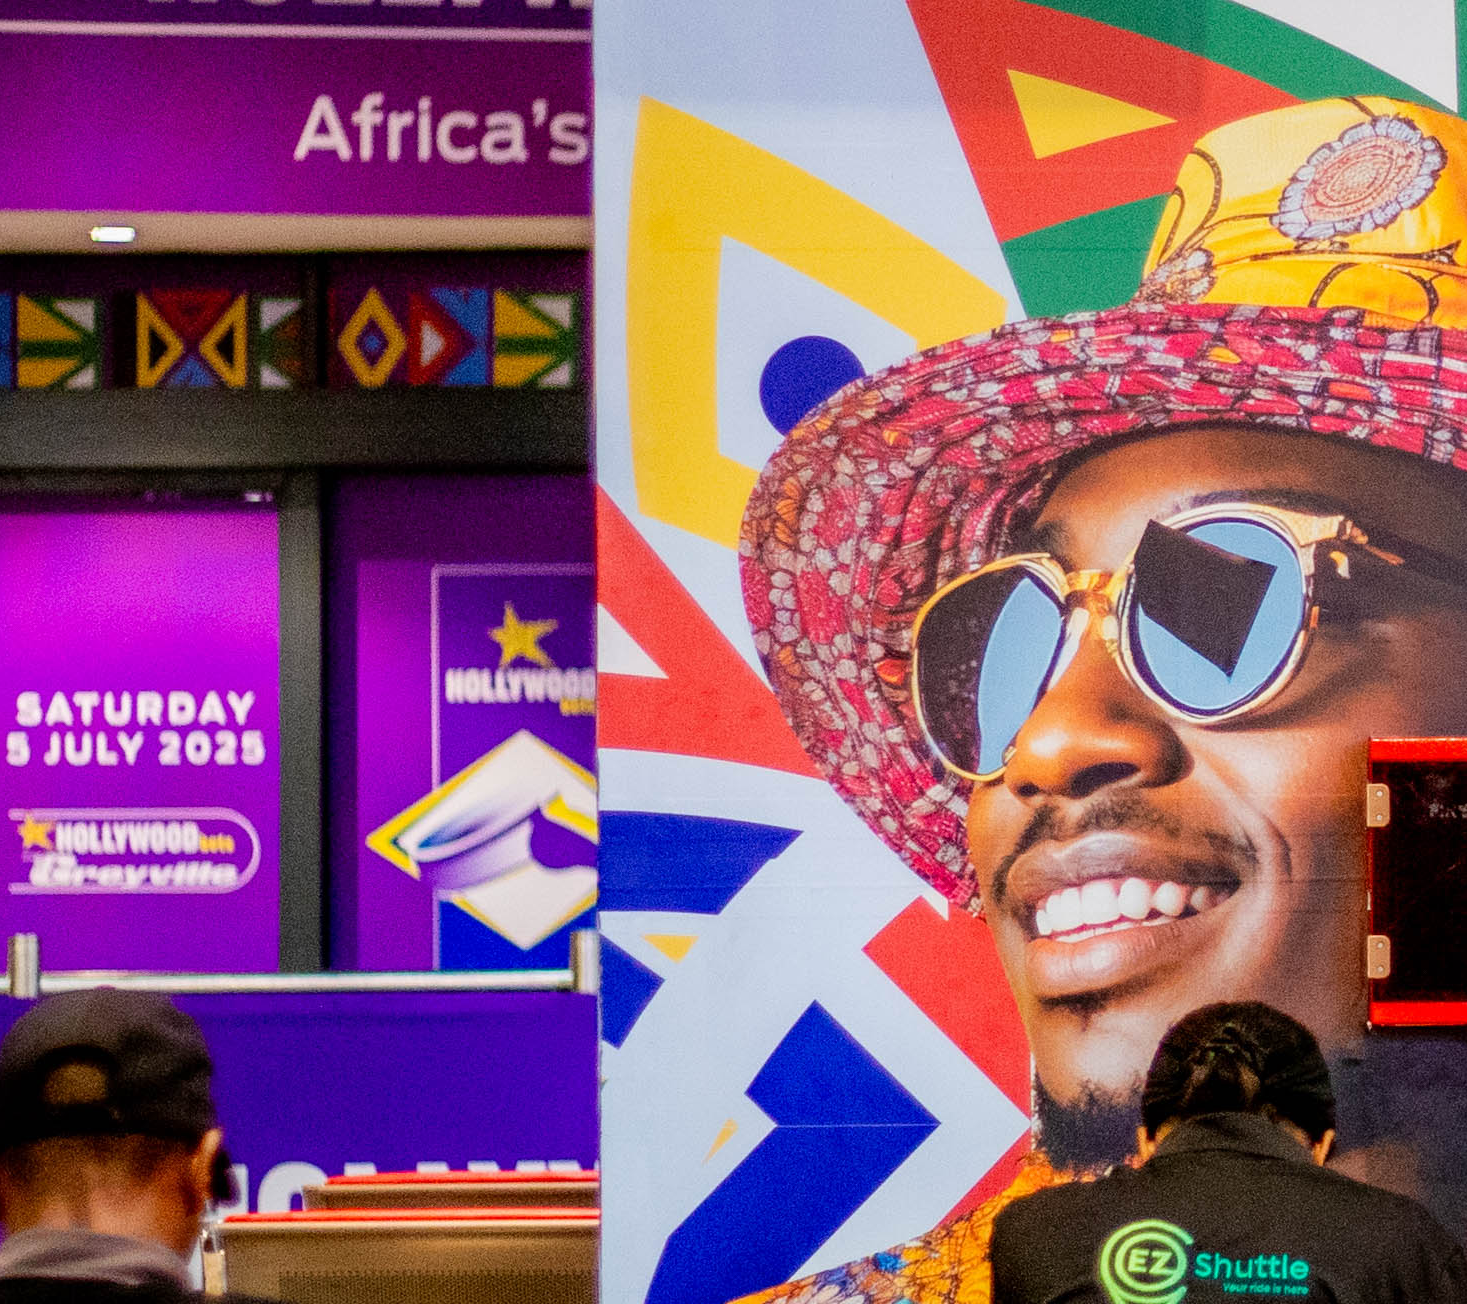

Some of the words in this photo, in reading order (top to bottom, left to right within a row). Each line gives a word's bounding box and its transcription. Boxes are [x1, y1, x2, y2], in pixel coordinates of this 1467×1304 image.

[293, 91, 590, 165] Africa's
[15, 691, 256, 728] SATURDAY
[6, 731, 31, 766] 5
[43, 731, 145, 766] JULY
[159, 731, 267, 766] 2025
[55, 821, 200, 855] HOLLYWOOD
[1127, 1248, 1178, 1276] EZ
[1193, 1251, 1311, 1280] Shuttle
